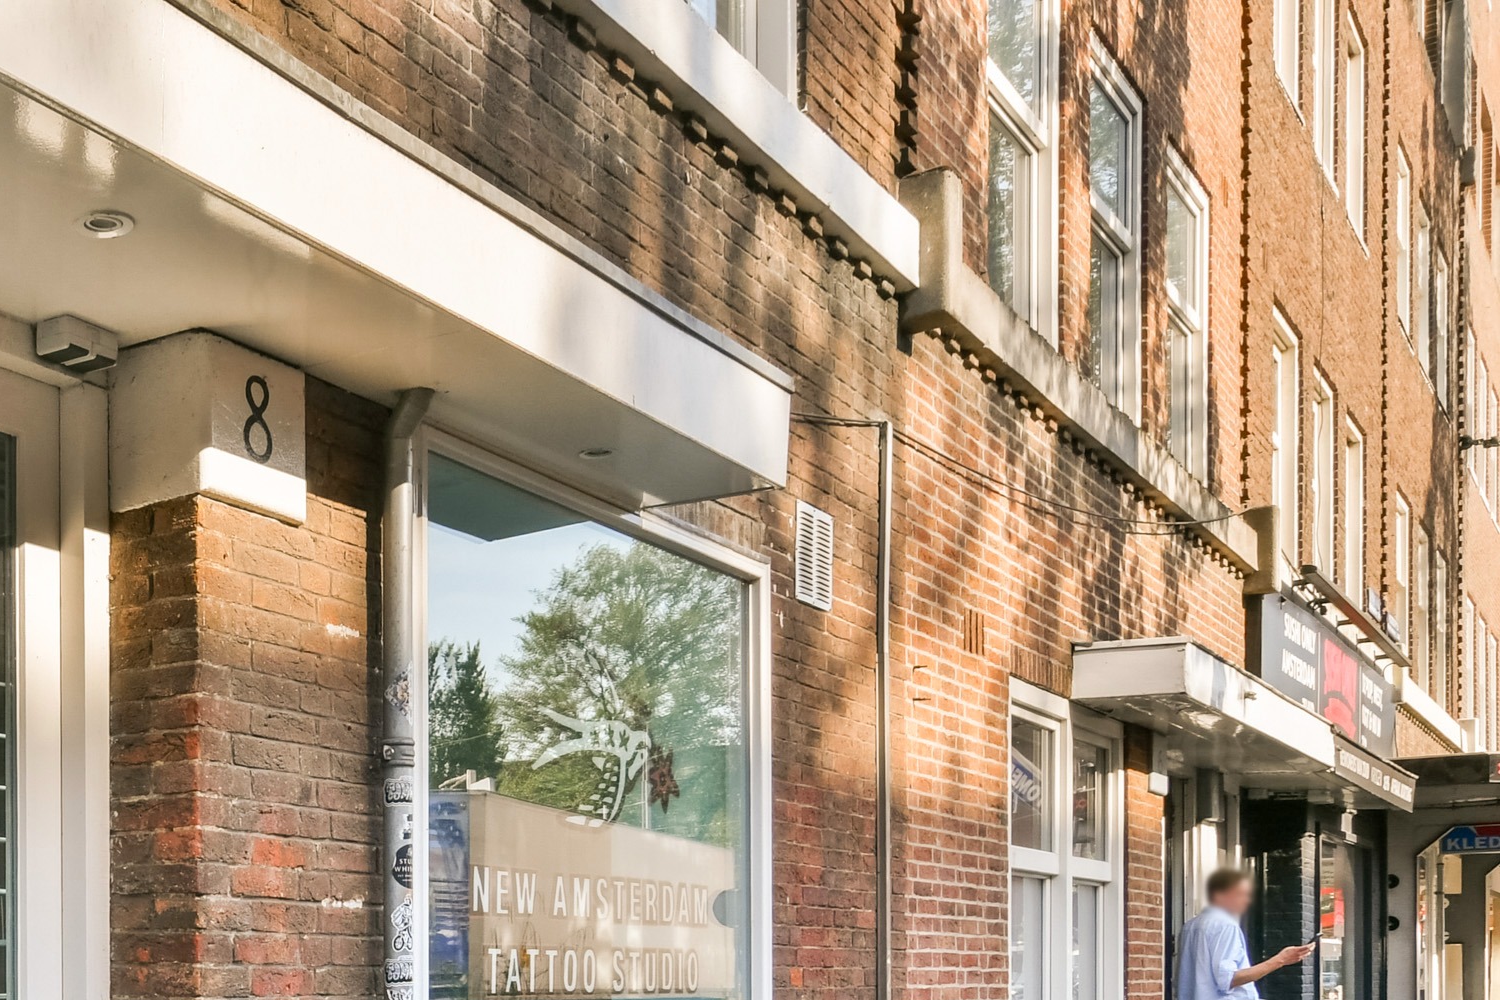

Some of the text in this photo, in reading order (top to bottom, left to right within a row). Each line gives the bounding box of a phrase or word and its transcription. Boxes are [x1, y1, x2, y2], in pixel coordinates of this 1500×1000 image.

[243, 375, 273, 464] 8
[472, 865, 709, 924] NEW AMSTERDAM
[488, 948, 698, 995] TATTOO STUDIO
